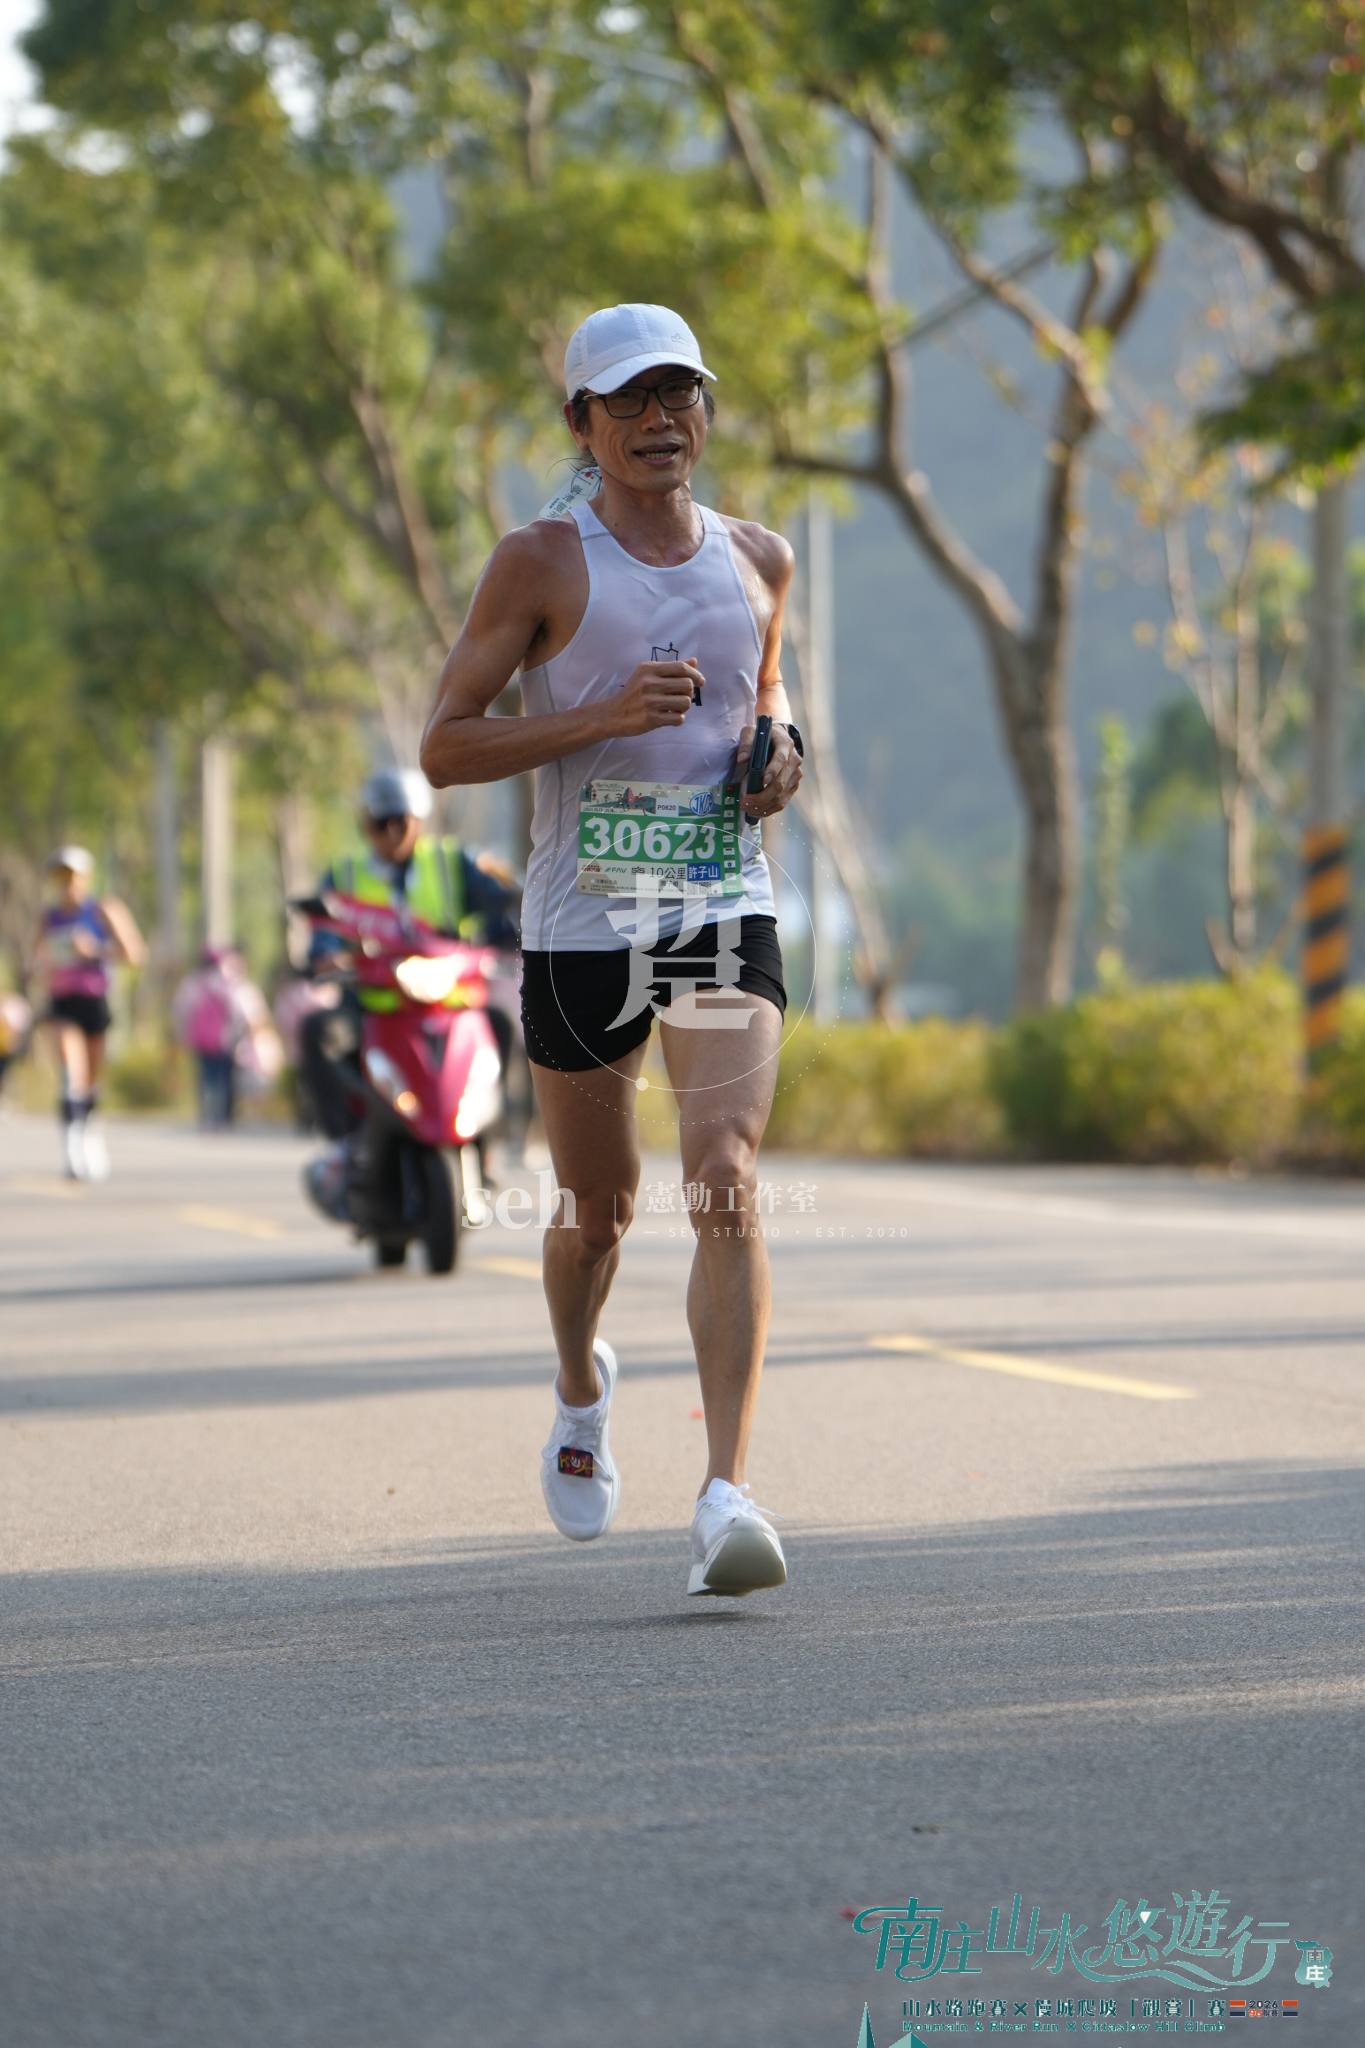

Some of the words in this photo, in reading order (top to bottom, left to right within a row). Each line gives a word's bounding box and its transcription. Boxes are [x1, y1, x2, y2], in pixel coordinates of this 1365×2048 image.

[584, 816, 716, 860] 30623
[650, 867, 686, 880] 10公里
[688, 864, 719, 880] 許子山
